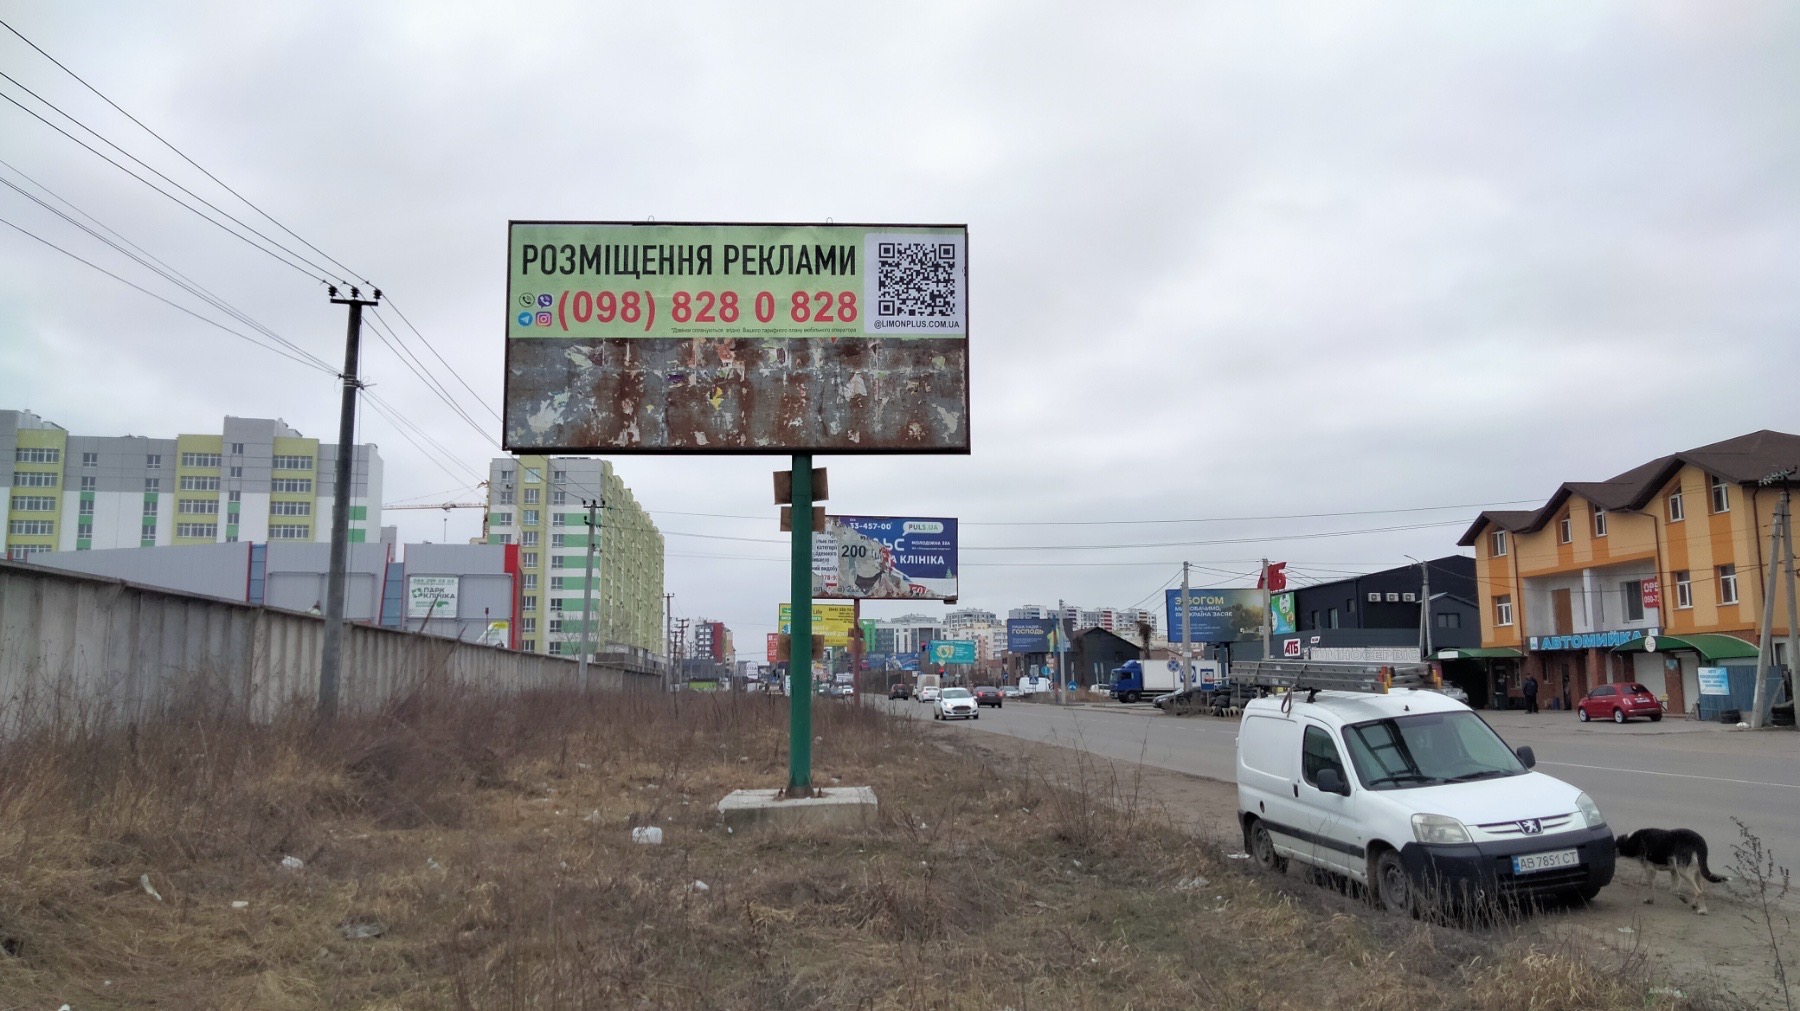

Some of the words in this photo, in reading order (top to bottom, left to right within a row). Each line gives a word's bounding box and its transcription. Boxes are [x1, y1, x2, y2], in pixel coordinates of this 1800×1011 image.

[522, 244, 712, 280] РОЗМІЩЕННЯ
[723, 244, 857, 276] РЕКЛАМИ
[558, 290, 656, 331] (098)
[671, 291, 739, 323] 828
[754, 291, 776, 323] 0
[791, 291, 858, 323] 828
[874, 320, 960, 330] @LIMONPLUS.COM.UA
[908, 523, 938, 531] PULS.UA
[841, 545, 866, 557] 200
[900, 555, 944, 565] КЛІНІКА
[1541, 630, 1642, 650] АВТОМИЙКА
[1284, 640, 1299, 655] АТБ
[1313, 648, 1420, 661] ШИНОСЕРВІС
[1520, 857, 1536, 869] AB
[1536, 854, 1561, 868] 7851
[1563, 852, 1577, 864] CT
